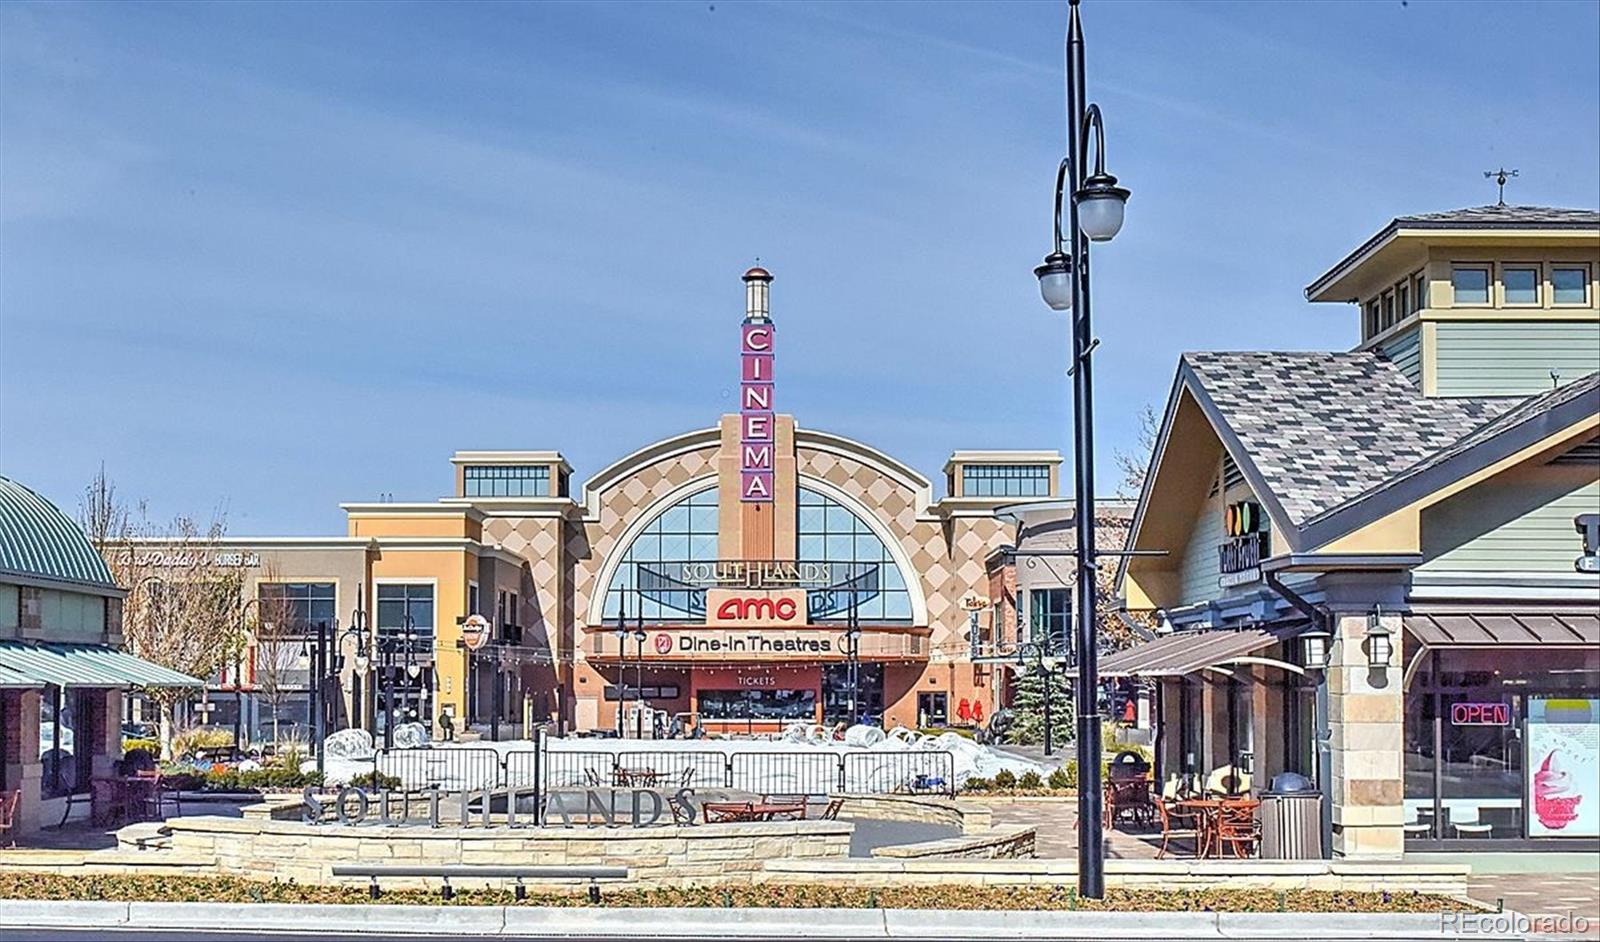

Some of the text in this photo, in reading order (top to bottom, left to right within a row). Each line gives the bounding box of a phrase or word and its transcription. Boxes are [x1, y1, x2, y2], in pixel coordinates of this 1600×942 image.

[745, 329, 769, 497] CINEMA
[682, 561, 831, 588] SOUTHLANDS
[679, 635, 831, 652] Dine-In Theatres
[738, 676, 776, 686] TICKETS
[1454, 705, 1507, 723] OPEN
[302, 786, 697, 829] SOUTHLANDS
